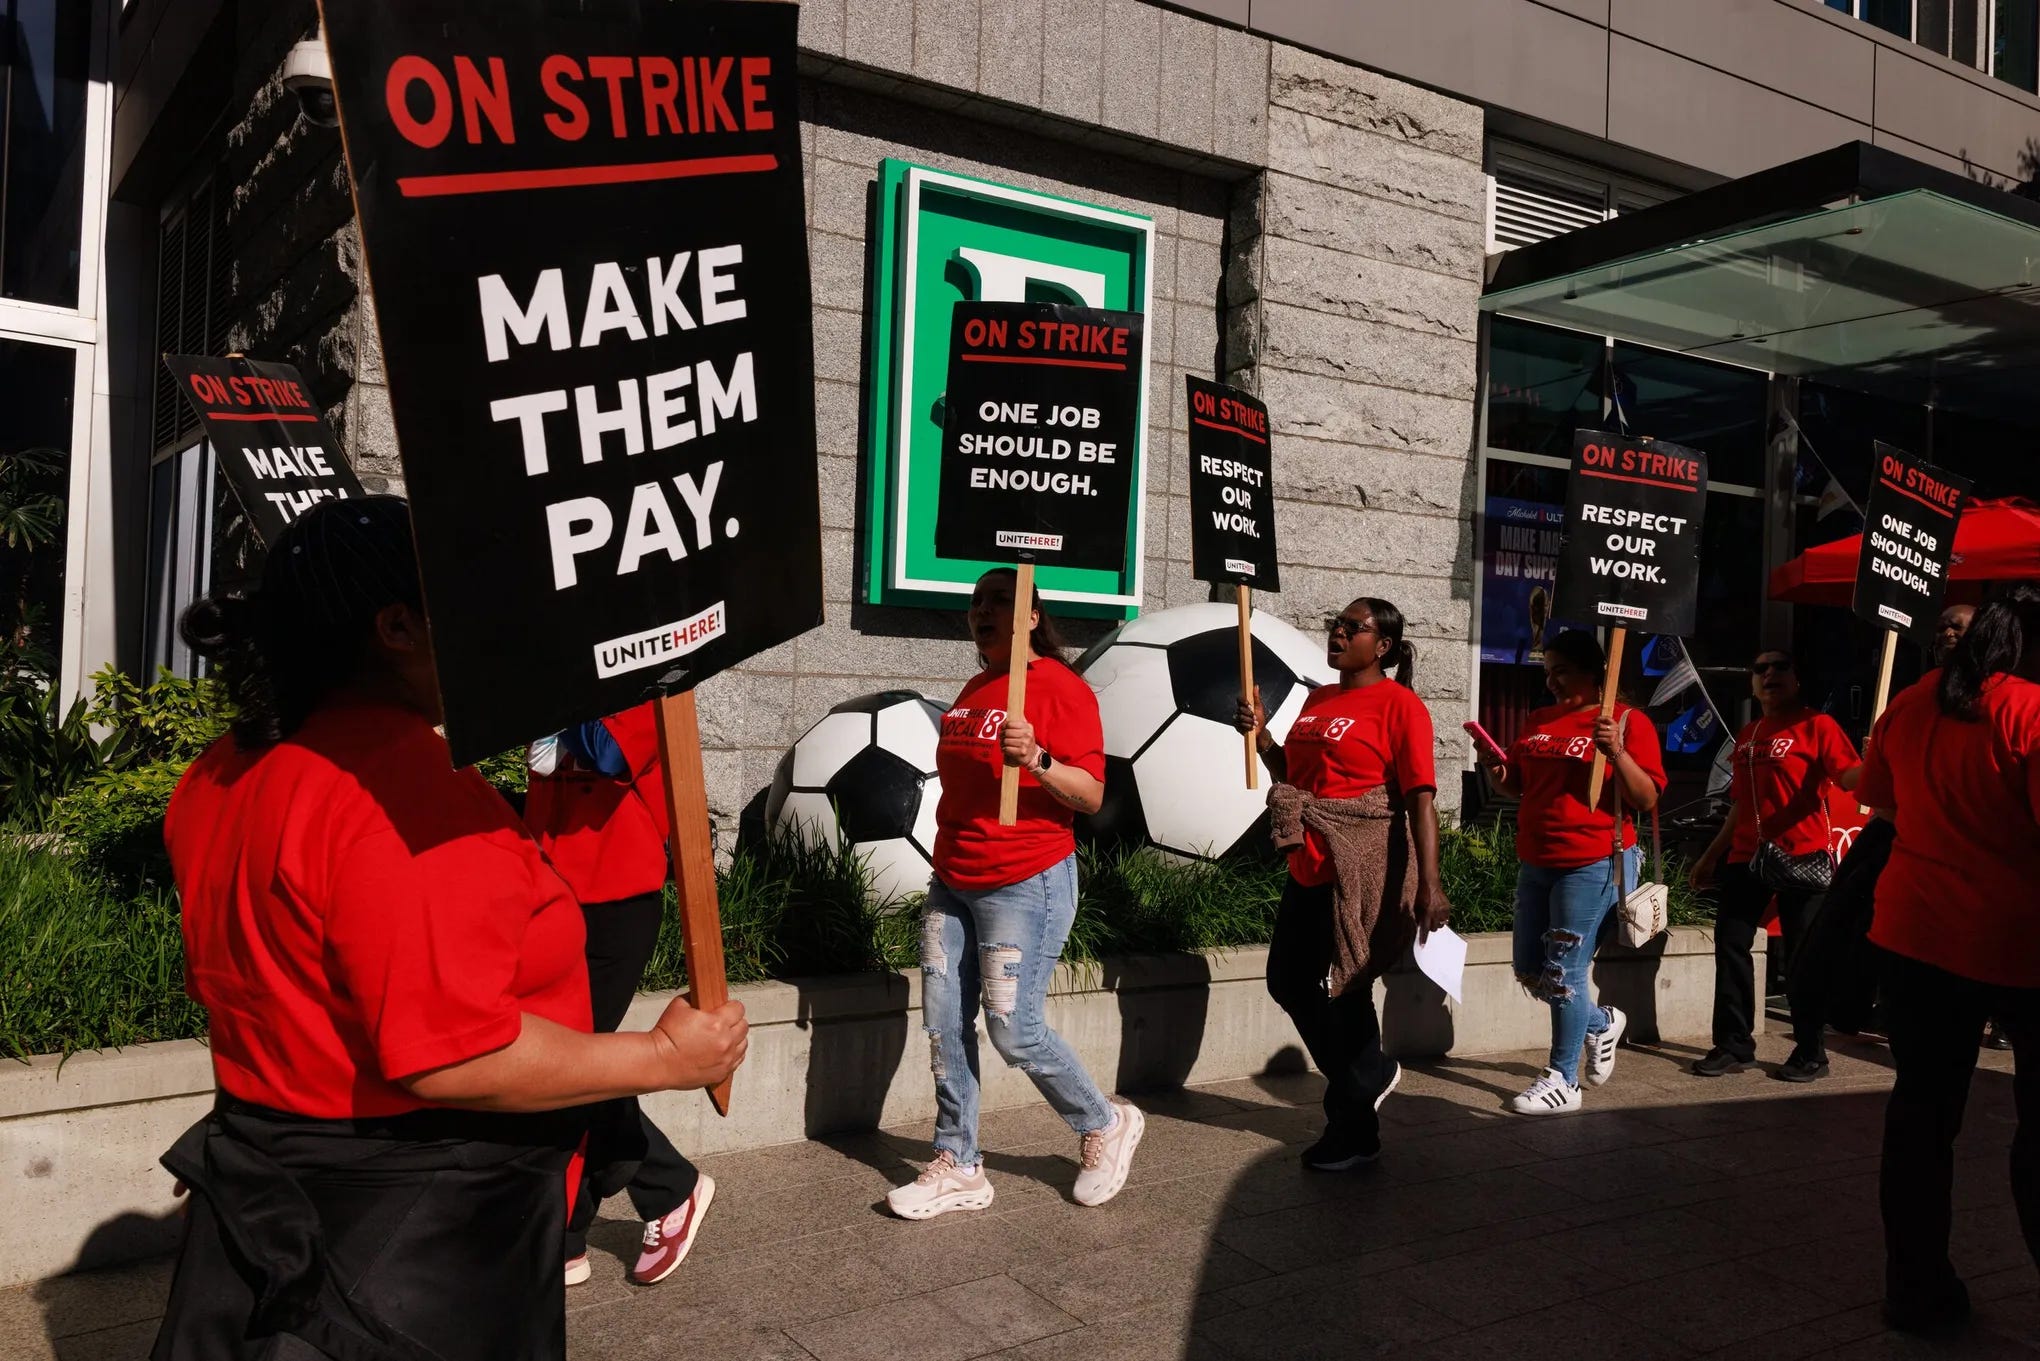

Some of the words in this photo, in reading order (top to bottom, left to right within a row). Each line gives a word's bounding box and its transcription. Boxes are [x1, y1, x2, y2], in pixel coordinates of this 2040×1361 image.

[386, 56, 515, 148] ON
[541, 55, 773, 140] STRIKE
[478, 245, 746, 362] MAKE
[965, 319, 1007, 347] ON
[1018, 321, 1129, 355] STRIKE
[191, 374, 231, 404] ON
[229, 377, 309, 407] STRIKE
[490, 352, 757, 476] THEM
[979, 402, 1038, 423] ONE
[1046, 406, 1100, 428] JOB
[1194, 391, 1214, 416] ON
[1221, 399, 1265, 432] STRIKE
[242, 447, 335, 479] MAKE
[959, 434, 1071, 459] SHOULD
[1079, 442, 1116, 463] BE
[1583, 444, 1615, 468] ON
[1622, 450, 1698, 481] STRIKE
[971, 468, 1097, 496] ENOUGH.
[1201, 455, 1263, 487] RESPECT
[1883, 456, 1903, 481] ON
[1906, 468, 1960, 508] STRIKE
[265, 488, 348, 523] TH
[1222, 487, 1251, 509] OUR
[546, 461, 739, 590] PAY.
[1213, 512, 1260, 538] WORK.
[1582, 504, 1686, 534] RESPECT
[1882, 514, 1911, 538] ONE
[1914, 529, 1936, 551] JOB
[1500, 525, 1536, 552] MAKE
[1607, 534, 1655, 556] OUR
[1871, 532, 1922, 566] SHOULD
[1923, 558, 1941, 577] BE
[1496, 550, 1521, 577] DAY
[1591, 557, 1666, 584] WORK.
[1872, 557, 1929, 596] ENOUGH.
